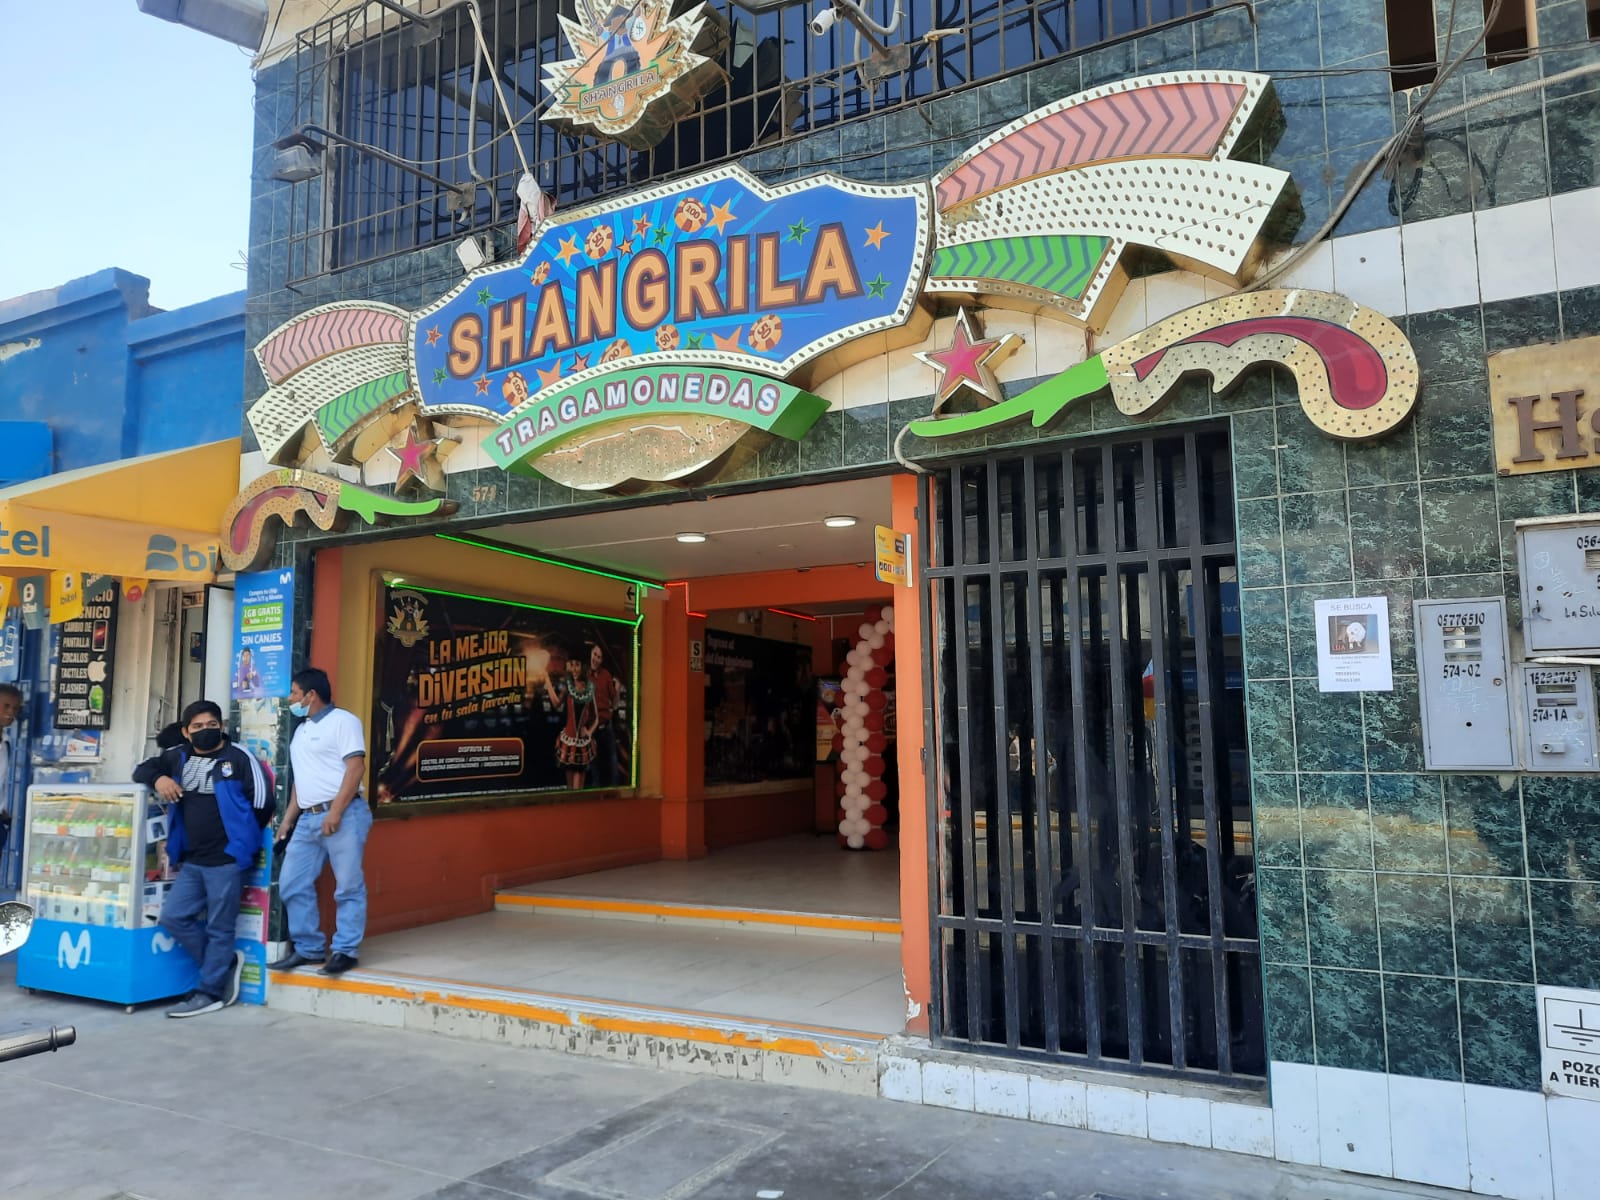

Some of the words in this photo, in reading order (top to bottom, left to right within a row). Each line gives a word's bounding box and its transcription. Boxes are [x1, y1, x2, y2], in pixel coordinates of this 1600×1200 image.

[583, 71, 655, 106] SHANGRILA
[686, 204, 701, 220] 100
[591, 233, 604, 248] 50
[447, 222, 864, 378] SHANGRILA
[755, 321, 772, 340] 50
[659, 333, 672, 346] 50
[511, 378, 524, 397] 100
[496, 374, 780, 456] TRAGAMONEDAS
[1330, 604, 1342, 612] SE
[1344, 603, 1373, 611] BUSCA
[1437, 612, 1486, 627] 05776510
[63, 637, 90, 648] PANTALLA
[242, 635, 254, 646] SIN
[429, 640, 451, 665] LA
[1443, 663, 1481, 679] 574-02
[424, 713, 439, 725] en
[456, 701, 478, 718] sala
[1549, 1071, 1560, 1082] A
[1564, 1073, 1600, 1088] TIER
